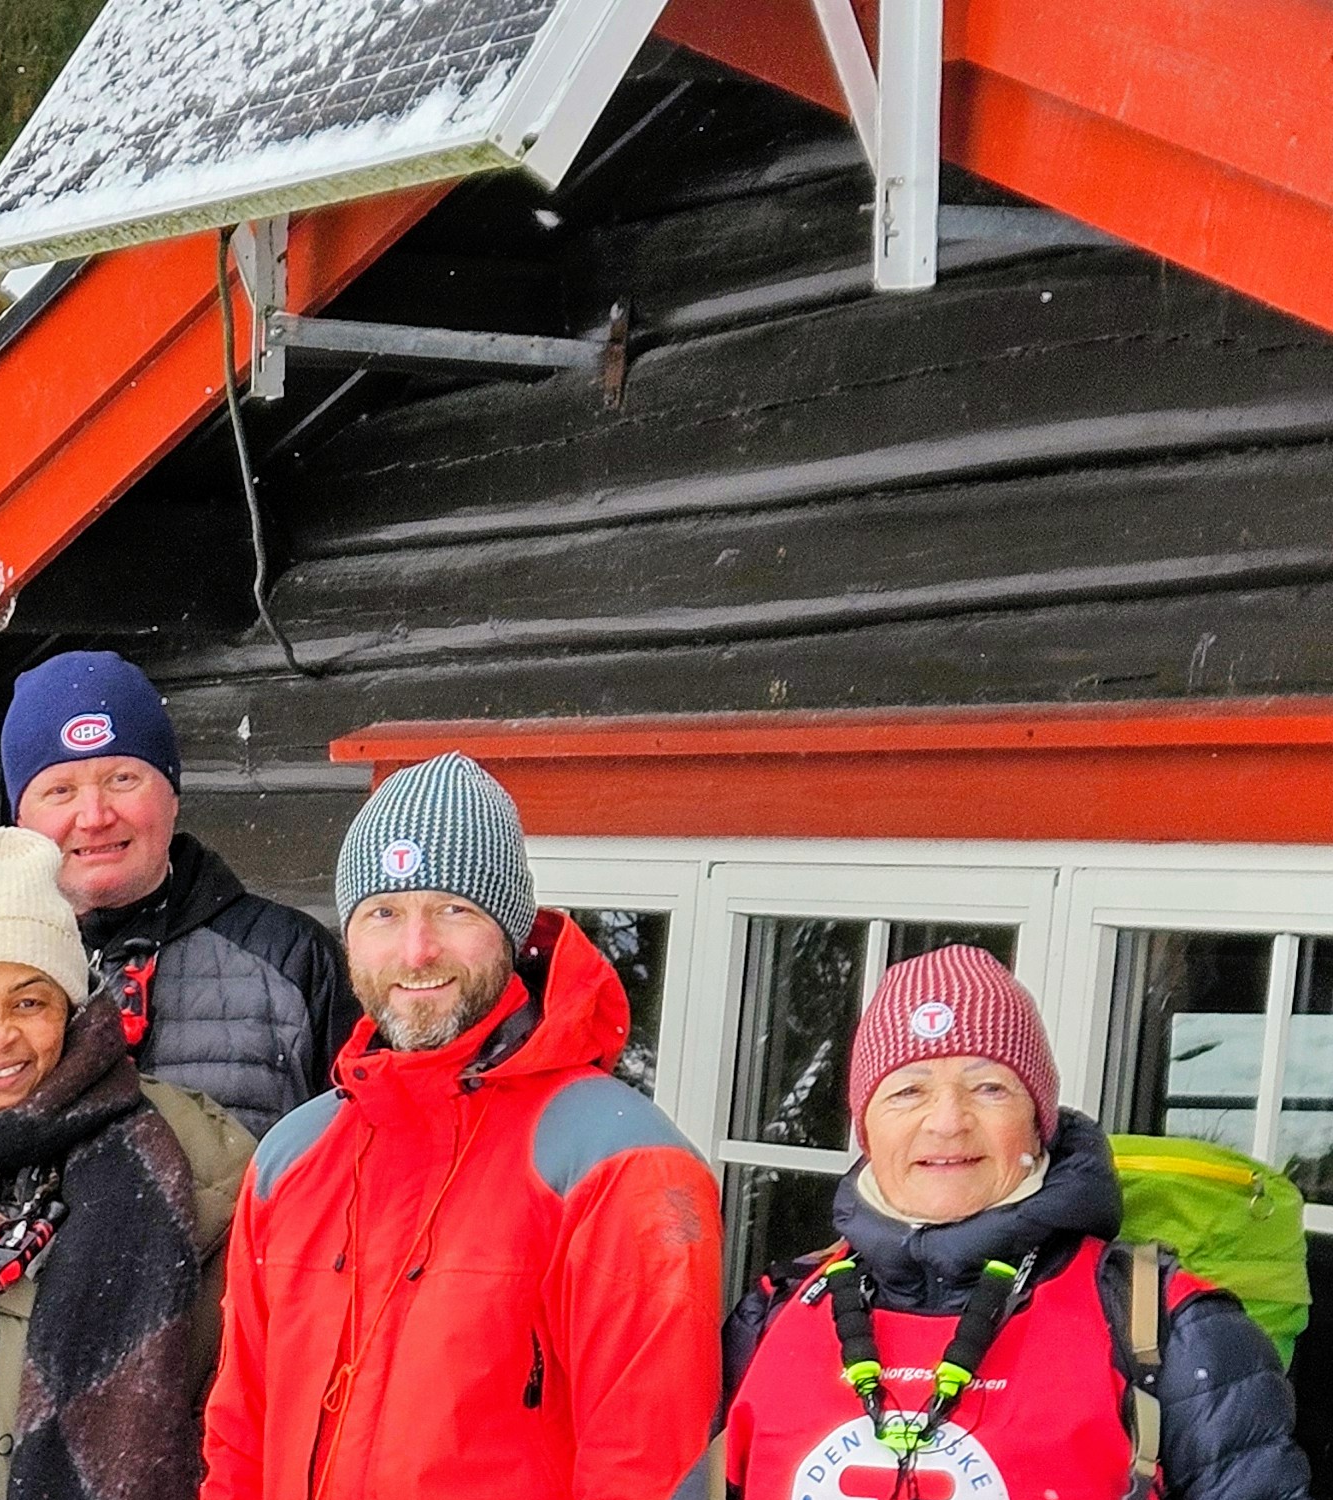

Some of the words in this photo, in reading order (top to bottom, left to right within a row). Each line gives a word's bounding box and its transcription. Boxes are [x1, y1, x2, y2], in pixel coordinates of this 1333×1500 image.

[393, 849, 410, 870] T
[923, 1011, 942, 1030] T
[806, 1430, 863, 1484] DEN
[932, 1429, 993, 1492] RSKE
